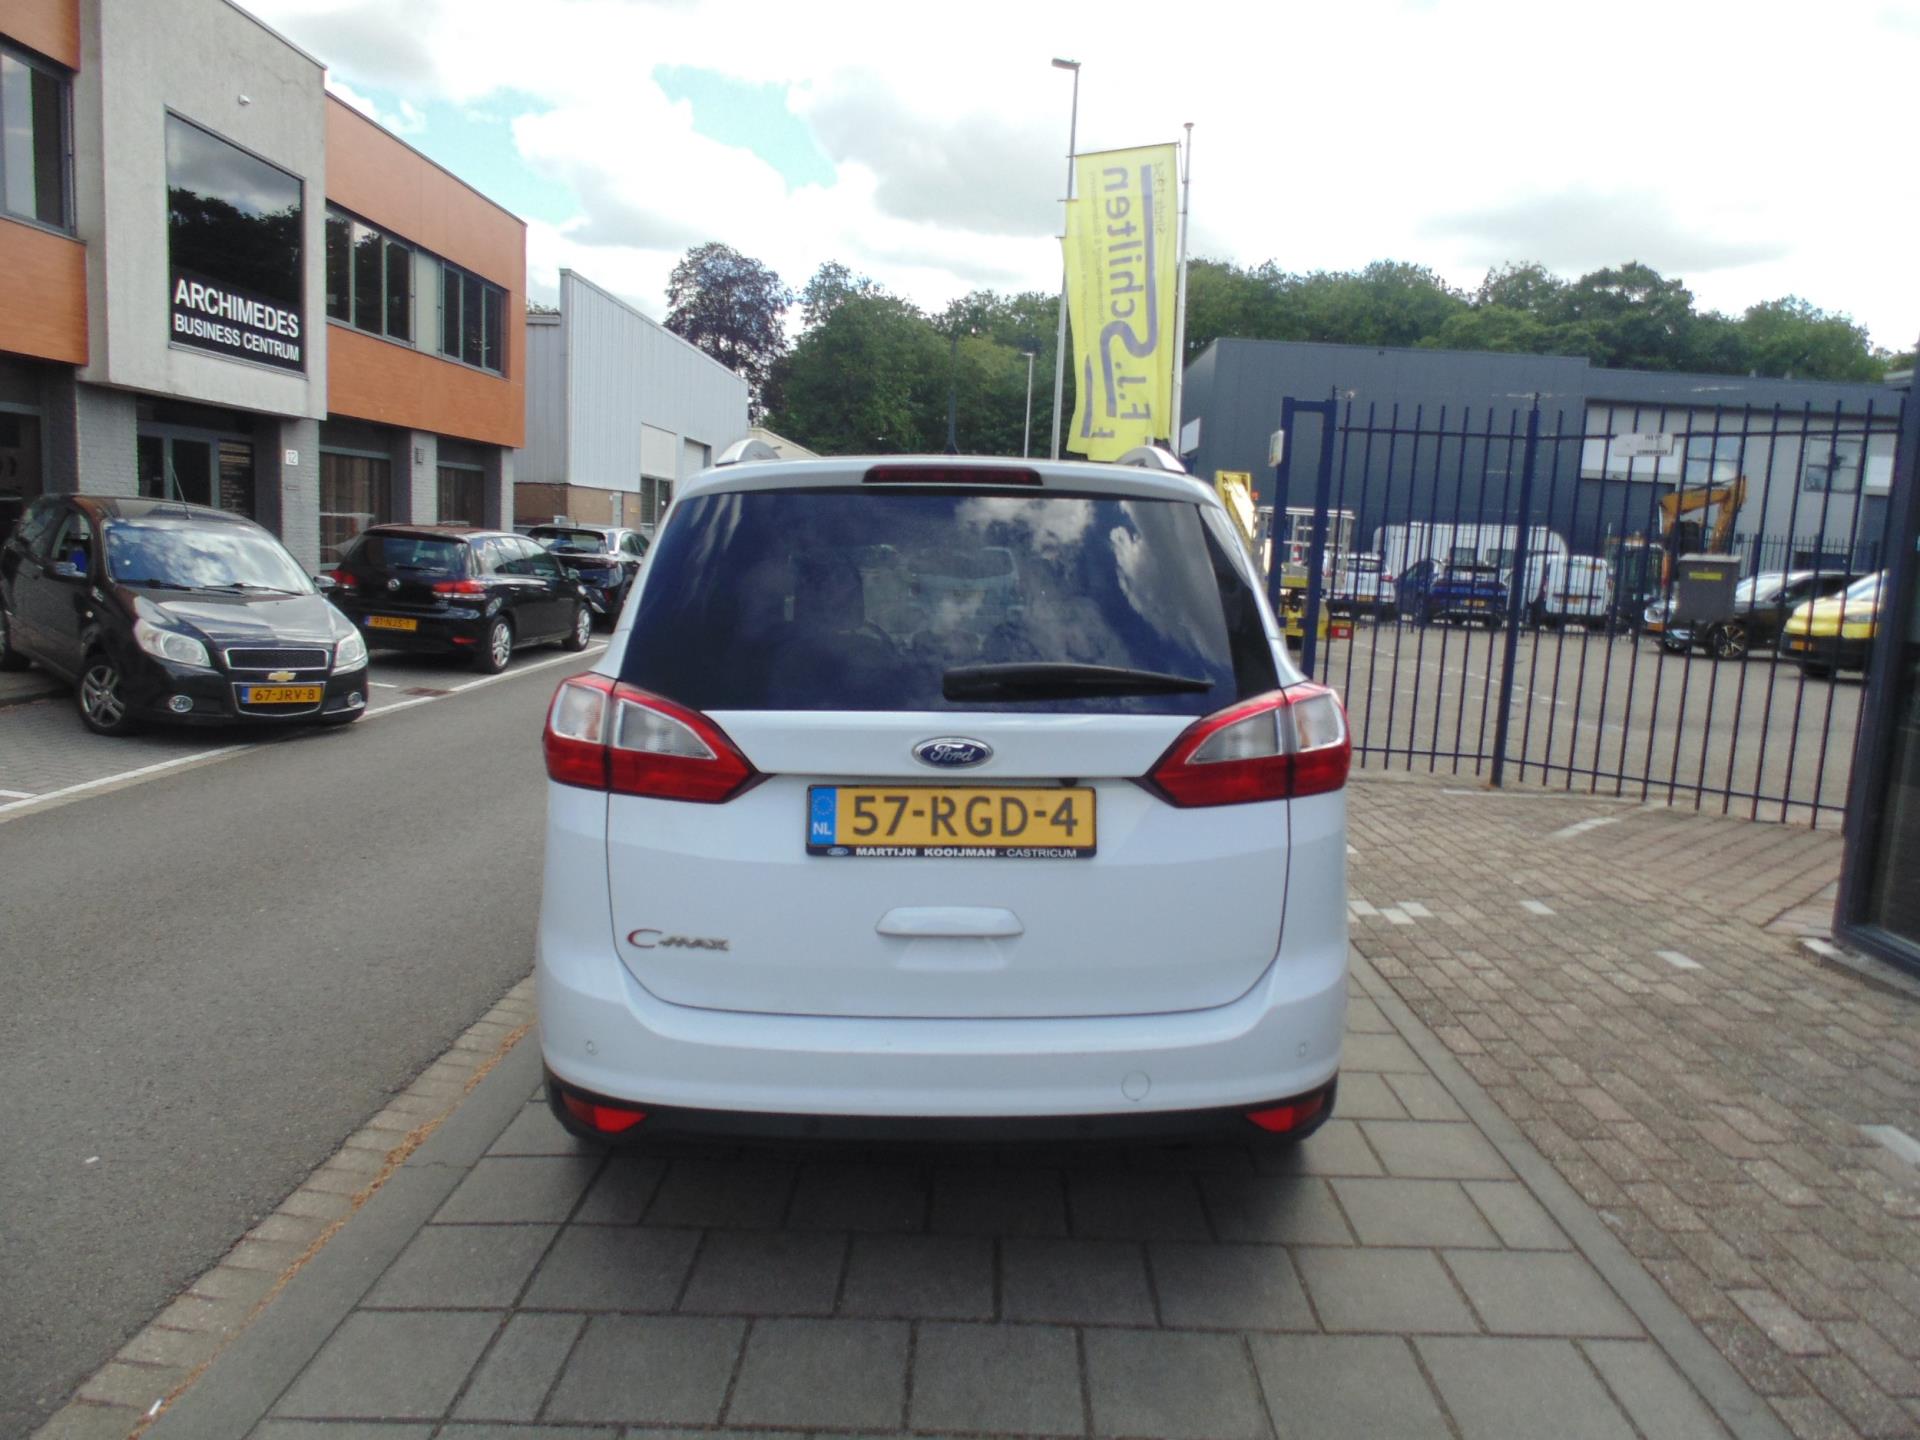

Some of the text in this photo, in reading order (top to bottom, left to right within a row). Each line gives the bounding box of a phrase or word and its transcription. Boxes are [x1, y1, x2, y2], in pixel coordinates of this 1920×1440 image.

[175, 278, 299, 338] ARCHIMEDES
[175, 313, 299, 361] BUSINESS CENTRUM
[255, 688, 315, 701] 67-JRV-8
[930, 743, 975, 761] Ford
[853, 795, 1078, 838] 57-RGD-4
[813, 822, 832, 836] NL
[856, 848, 916, 857] MARTIJN
[924, 848, 996, 857] KOOIJMAN
[1006, 848, 1077, 858] CASTRICUM
